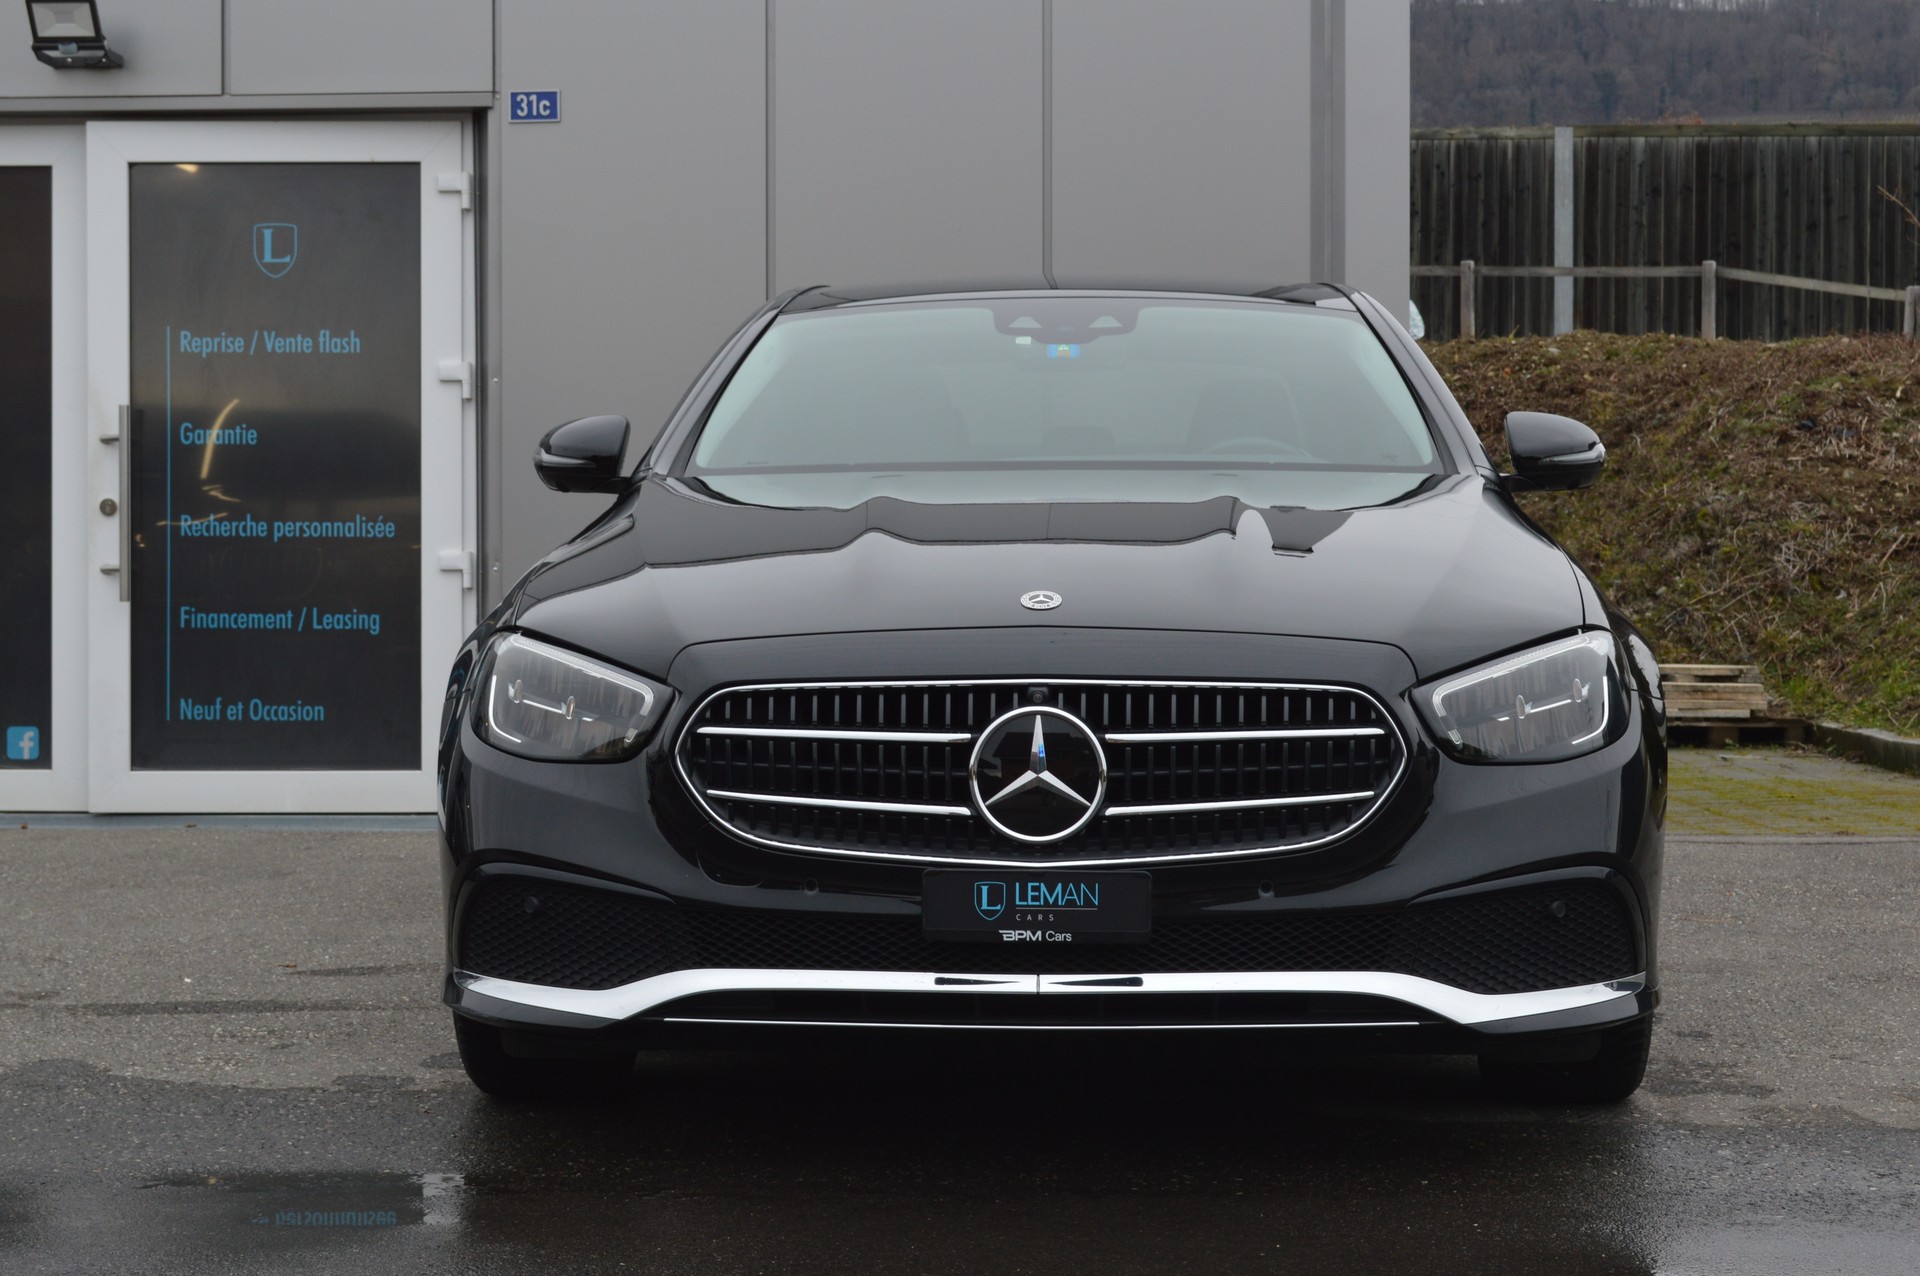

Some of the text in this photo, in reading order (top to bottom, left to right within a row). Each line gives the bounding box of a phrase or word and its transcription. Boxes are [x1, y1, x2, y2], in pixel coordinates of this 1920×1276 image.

[516, 94, 551, 117] 31c
[262, 228, 291, 264] L
[179, 329, 361, 358] Reprise / Vente flash
[179, 422, 258, 446] Garantie
[179, 513, 396, 542] Recherche personnalisée
[179, 605, 381, 635] Financement / Leasing
[179, 696, 325, 722] Neuf et Occasion
[980, 885, 1001, 910] L
[1015, 882, 1099, 906] LEMAN
[1015, 913, 1054, 922] CARS
[998, 930, 1072, 942] BPM Cars
